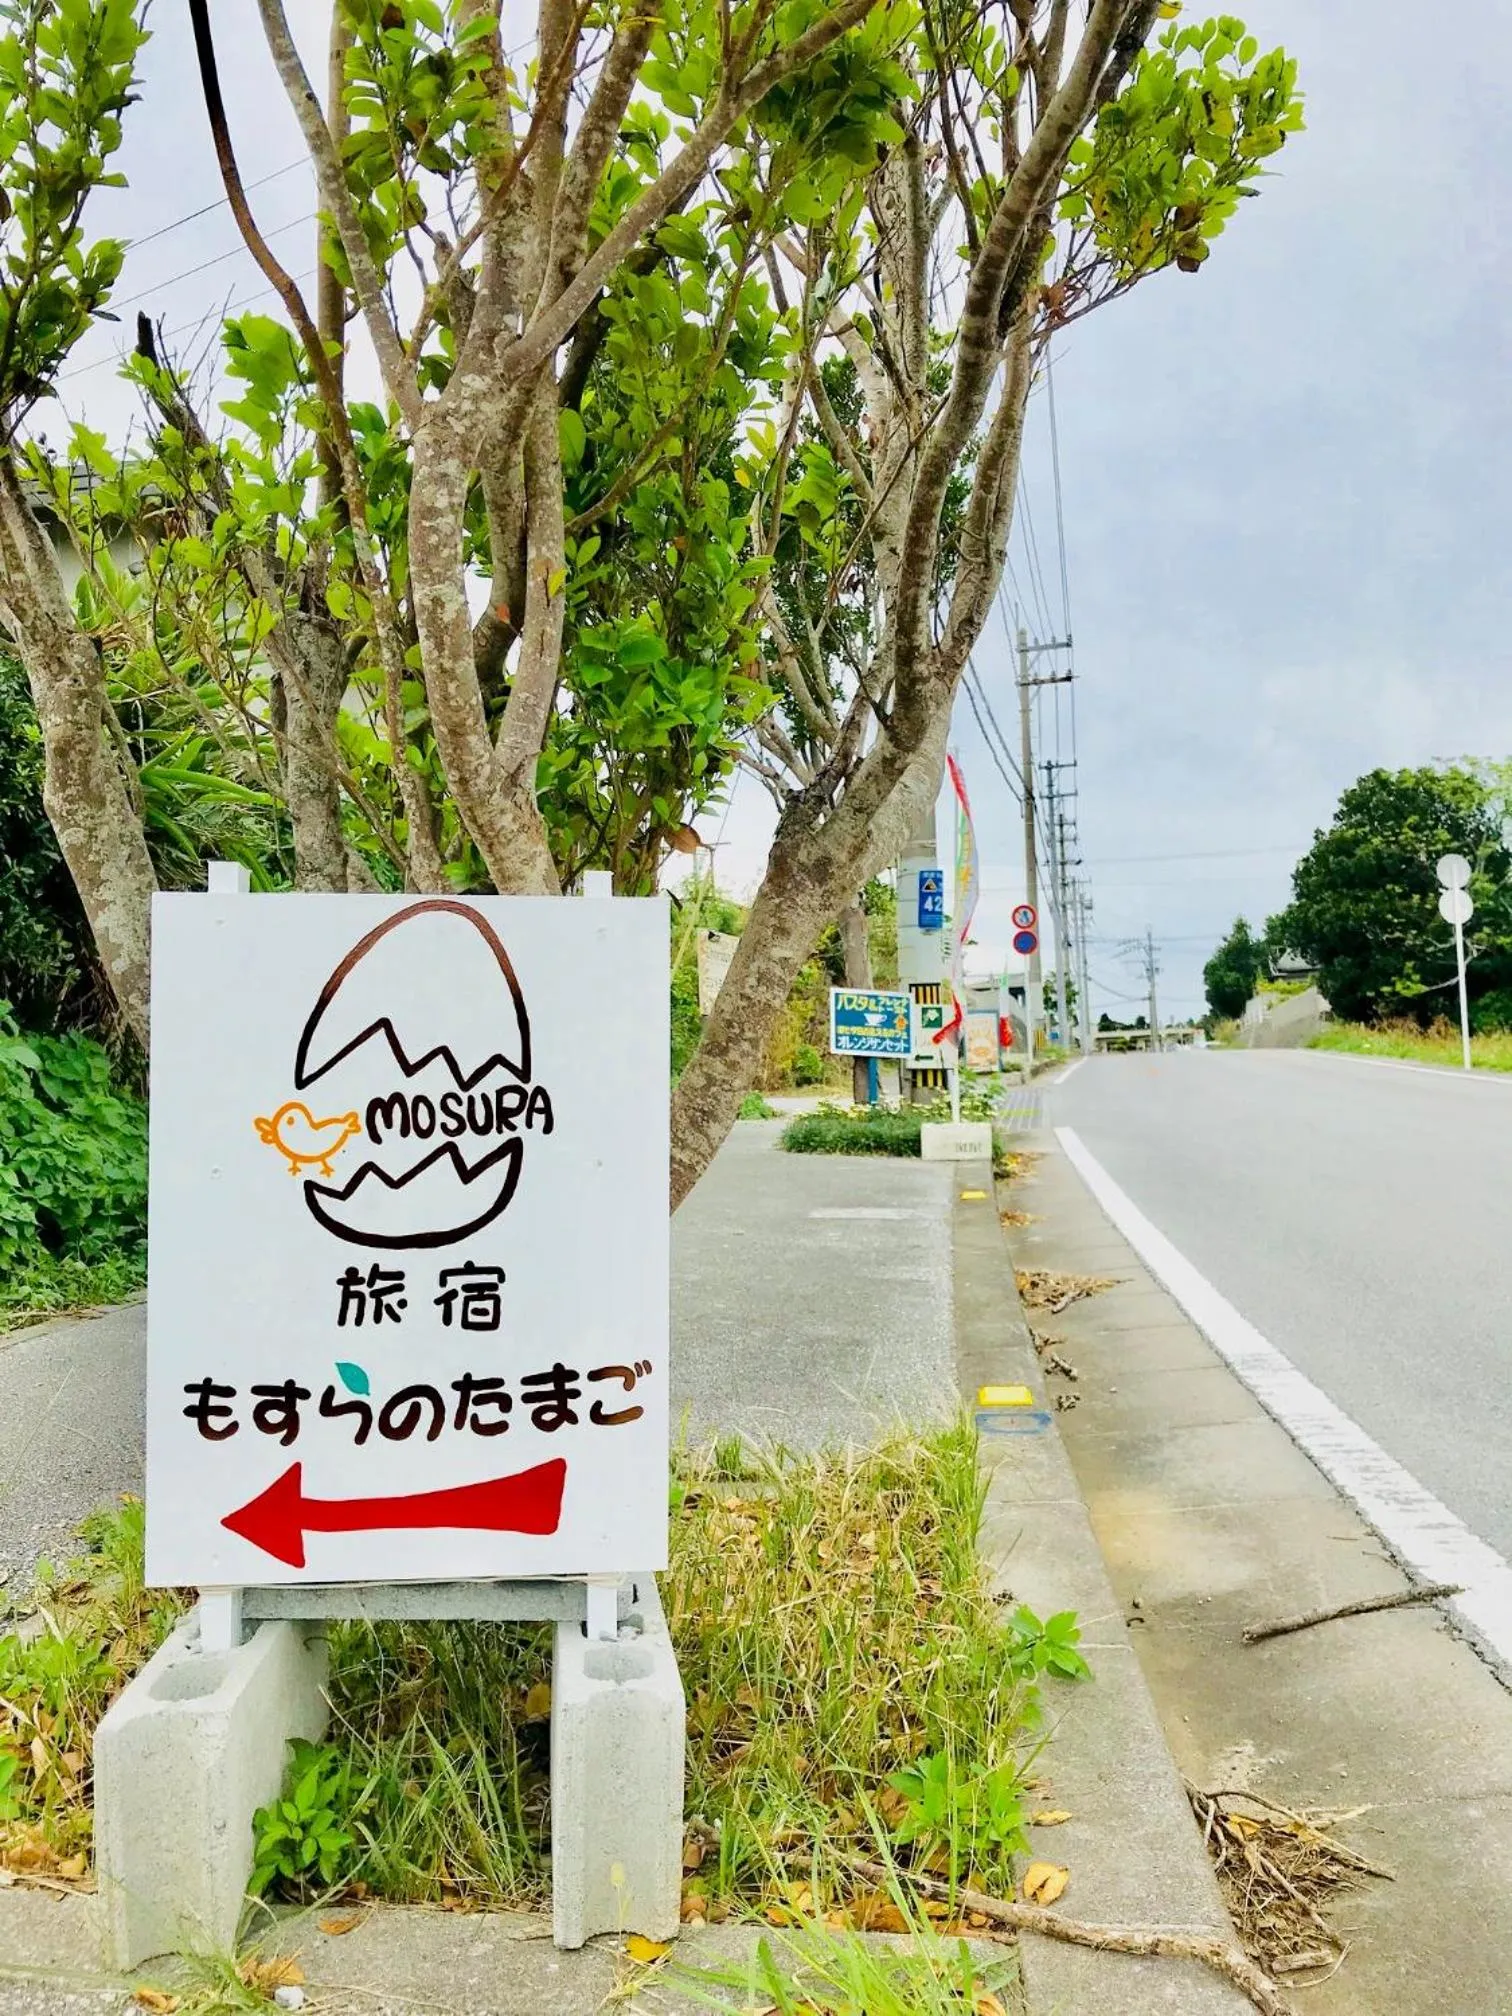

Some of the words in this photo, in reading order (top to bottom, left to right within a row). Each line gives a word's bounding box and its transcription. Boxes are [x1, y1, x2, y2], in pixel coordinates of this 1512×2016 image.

[366, 1083, 555, 1143] MOSURA
[183, 1360, 652, 1446] もすらのたまご
